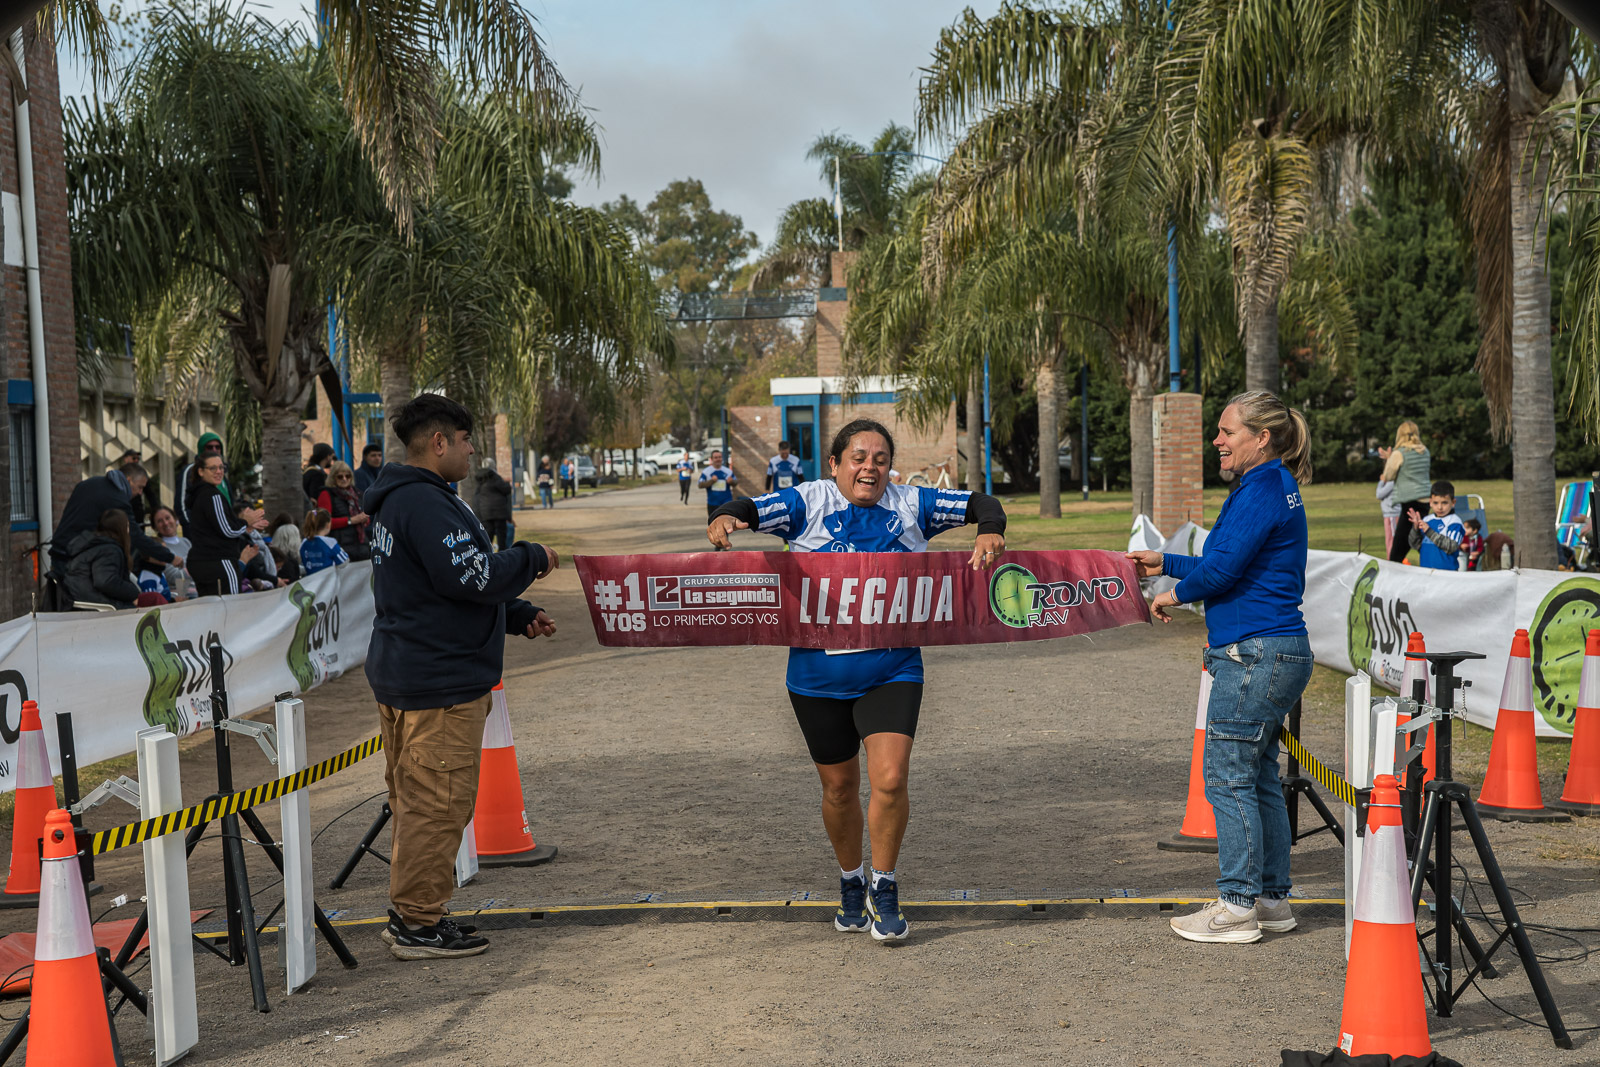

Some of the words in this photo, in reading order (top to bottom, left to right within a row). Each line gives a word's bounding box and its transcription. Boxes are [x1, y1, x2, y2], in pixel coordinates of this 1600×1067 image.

[684, 577, 715, 585] GRUPO
[717, 576, 775, 584] ASEGURADOR
[594, 572, 645, 610] #1
[705, 587, 775, 606] segunda
[800, 576, 953, 625] LLEGADA
[601, 612, 647, 632] VOS
[653, 615, 671, 627] LO
[674, 613, 727, 627] PRIMERO
[730, 613, 754, 625] SOS
[755, 613, 779, 625] VOS
[1027, 609, 1070, 628] RAV
